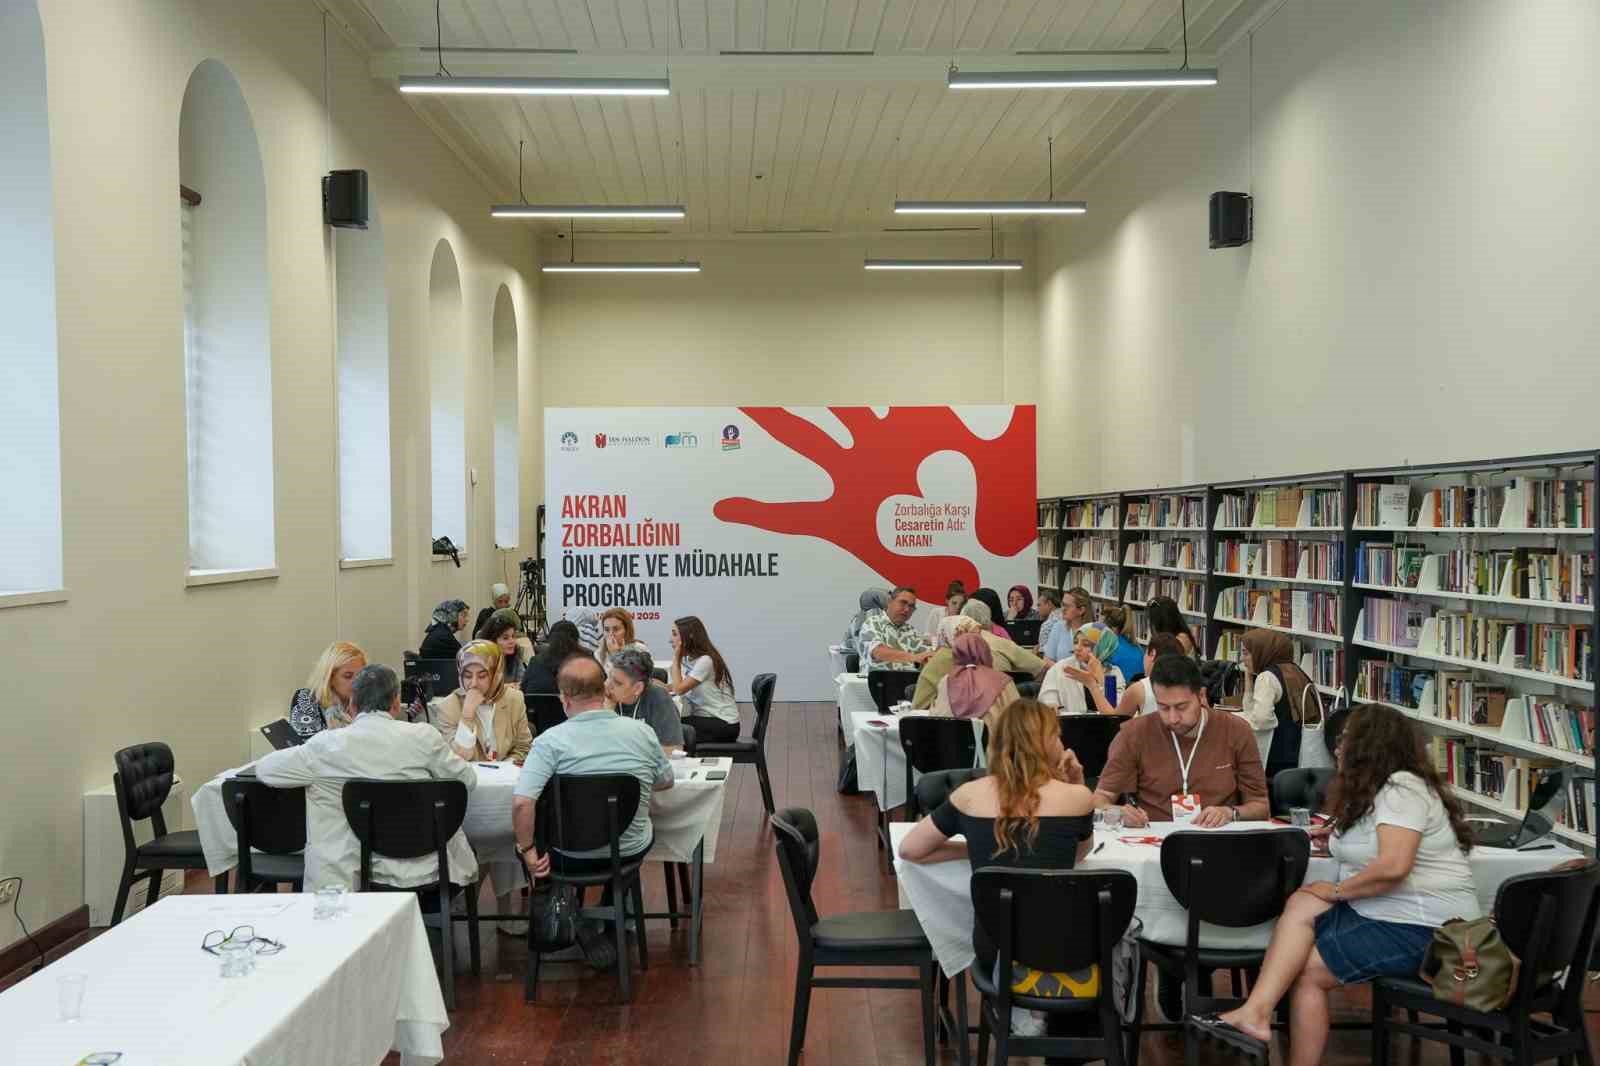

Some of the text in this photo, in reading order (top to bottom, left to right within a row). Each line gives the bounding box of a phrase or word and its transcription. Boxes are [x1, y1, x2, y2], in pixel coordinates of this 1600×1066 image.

[561, 495, 627, 518] AKRAN
[895, 503, 970, 518] Zorbalığa Karşı
[561, 518, 680, 547] ZORBALIĞINI
[895, 518, 944, 531] Cesaretin
[895, 534, 933, 547] AKRAN!
[562, 549, 779, 578] ÖNLEME VE MÜDAHALE
[562, 582, 662, 607] PROGRAMI
[637, 612, 660, 620] 2025
